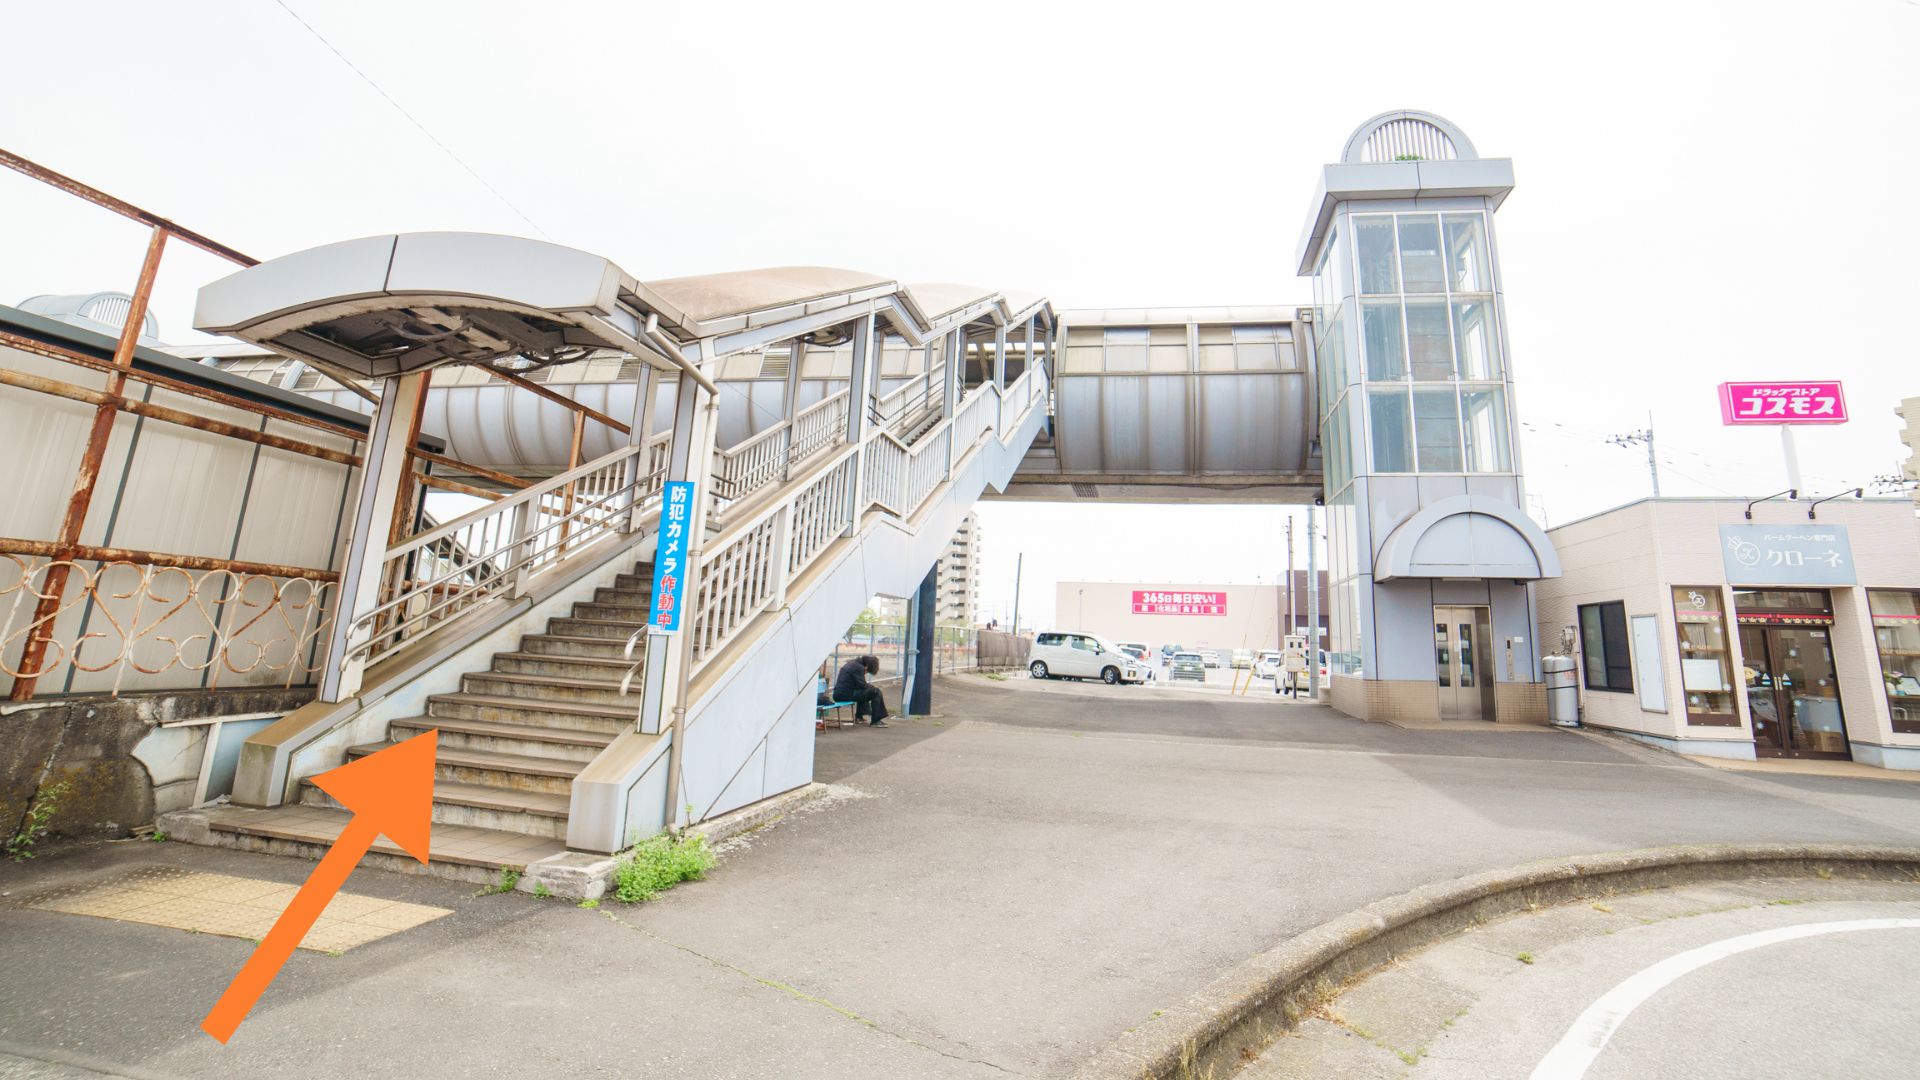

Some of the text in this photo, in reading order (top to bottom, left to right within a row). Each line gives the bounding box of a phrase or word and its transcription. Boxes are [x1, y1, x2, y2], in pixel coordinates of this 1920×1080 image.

[1752, 387, 1820, 397] ドラッグストア
[1740, 396, 1836, 415] コスモス
[657, 485, 687, 629] 防犯カメラ作動中
[1766, 549, 1844, 568] クローネ
